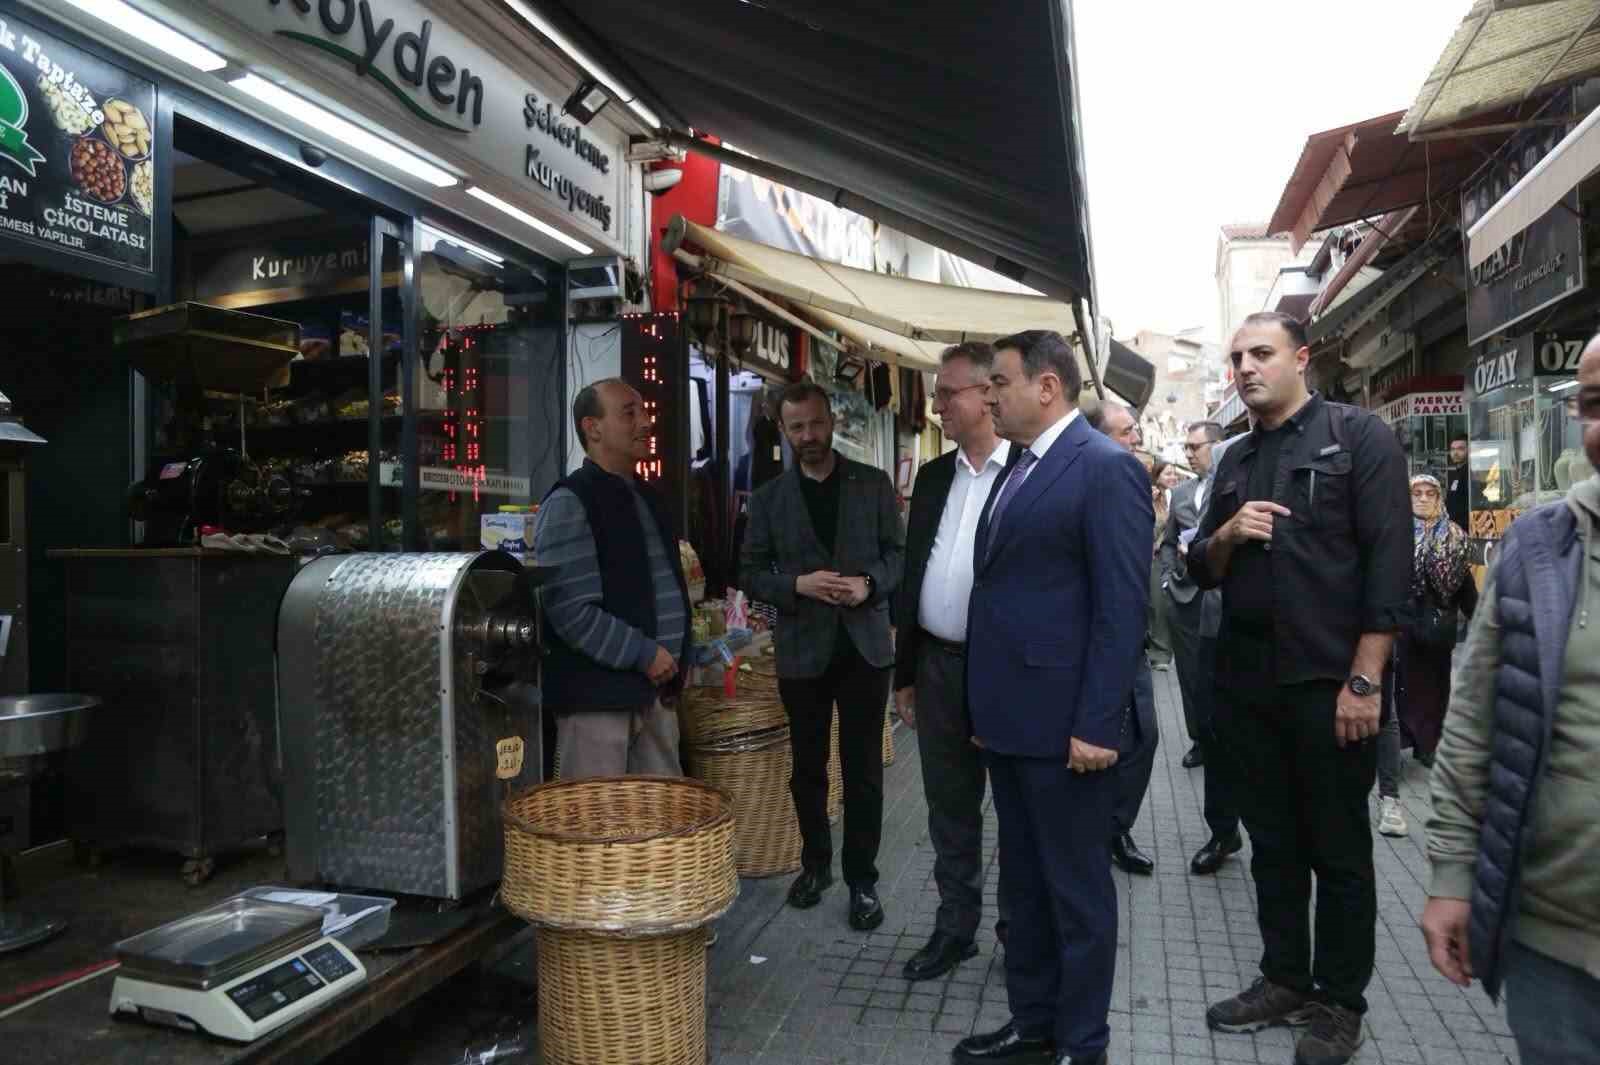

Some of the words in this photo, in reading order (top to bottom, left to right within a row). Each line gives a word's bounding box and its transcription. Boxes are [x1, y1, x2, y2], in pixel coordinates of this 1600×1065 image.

[21, 34, 104, 126] Taptaze
[523, 93, 610, 175] Şekerleme
[526, 143, 611, 232] Kuruyemiş
[43, 207, 145, 249] ÇİKOLATASI
[64, 193, 128, 228] İSTEME
[37, 226, 86, 249] YAPILIR.
[1474, 349, 1518, 394] ÖZAY
[1414, 395, 1462, 405] MERVE
